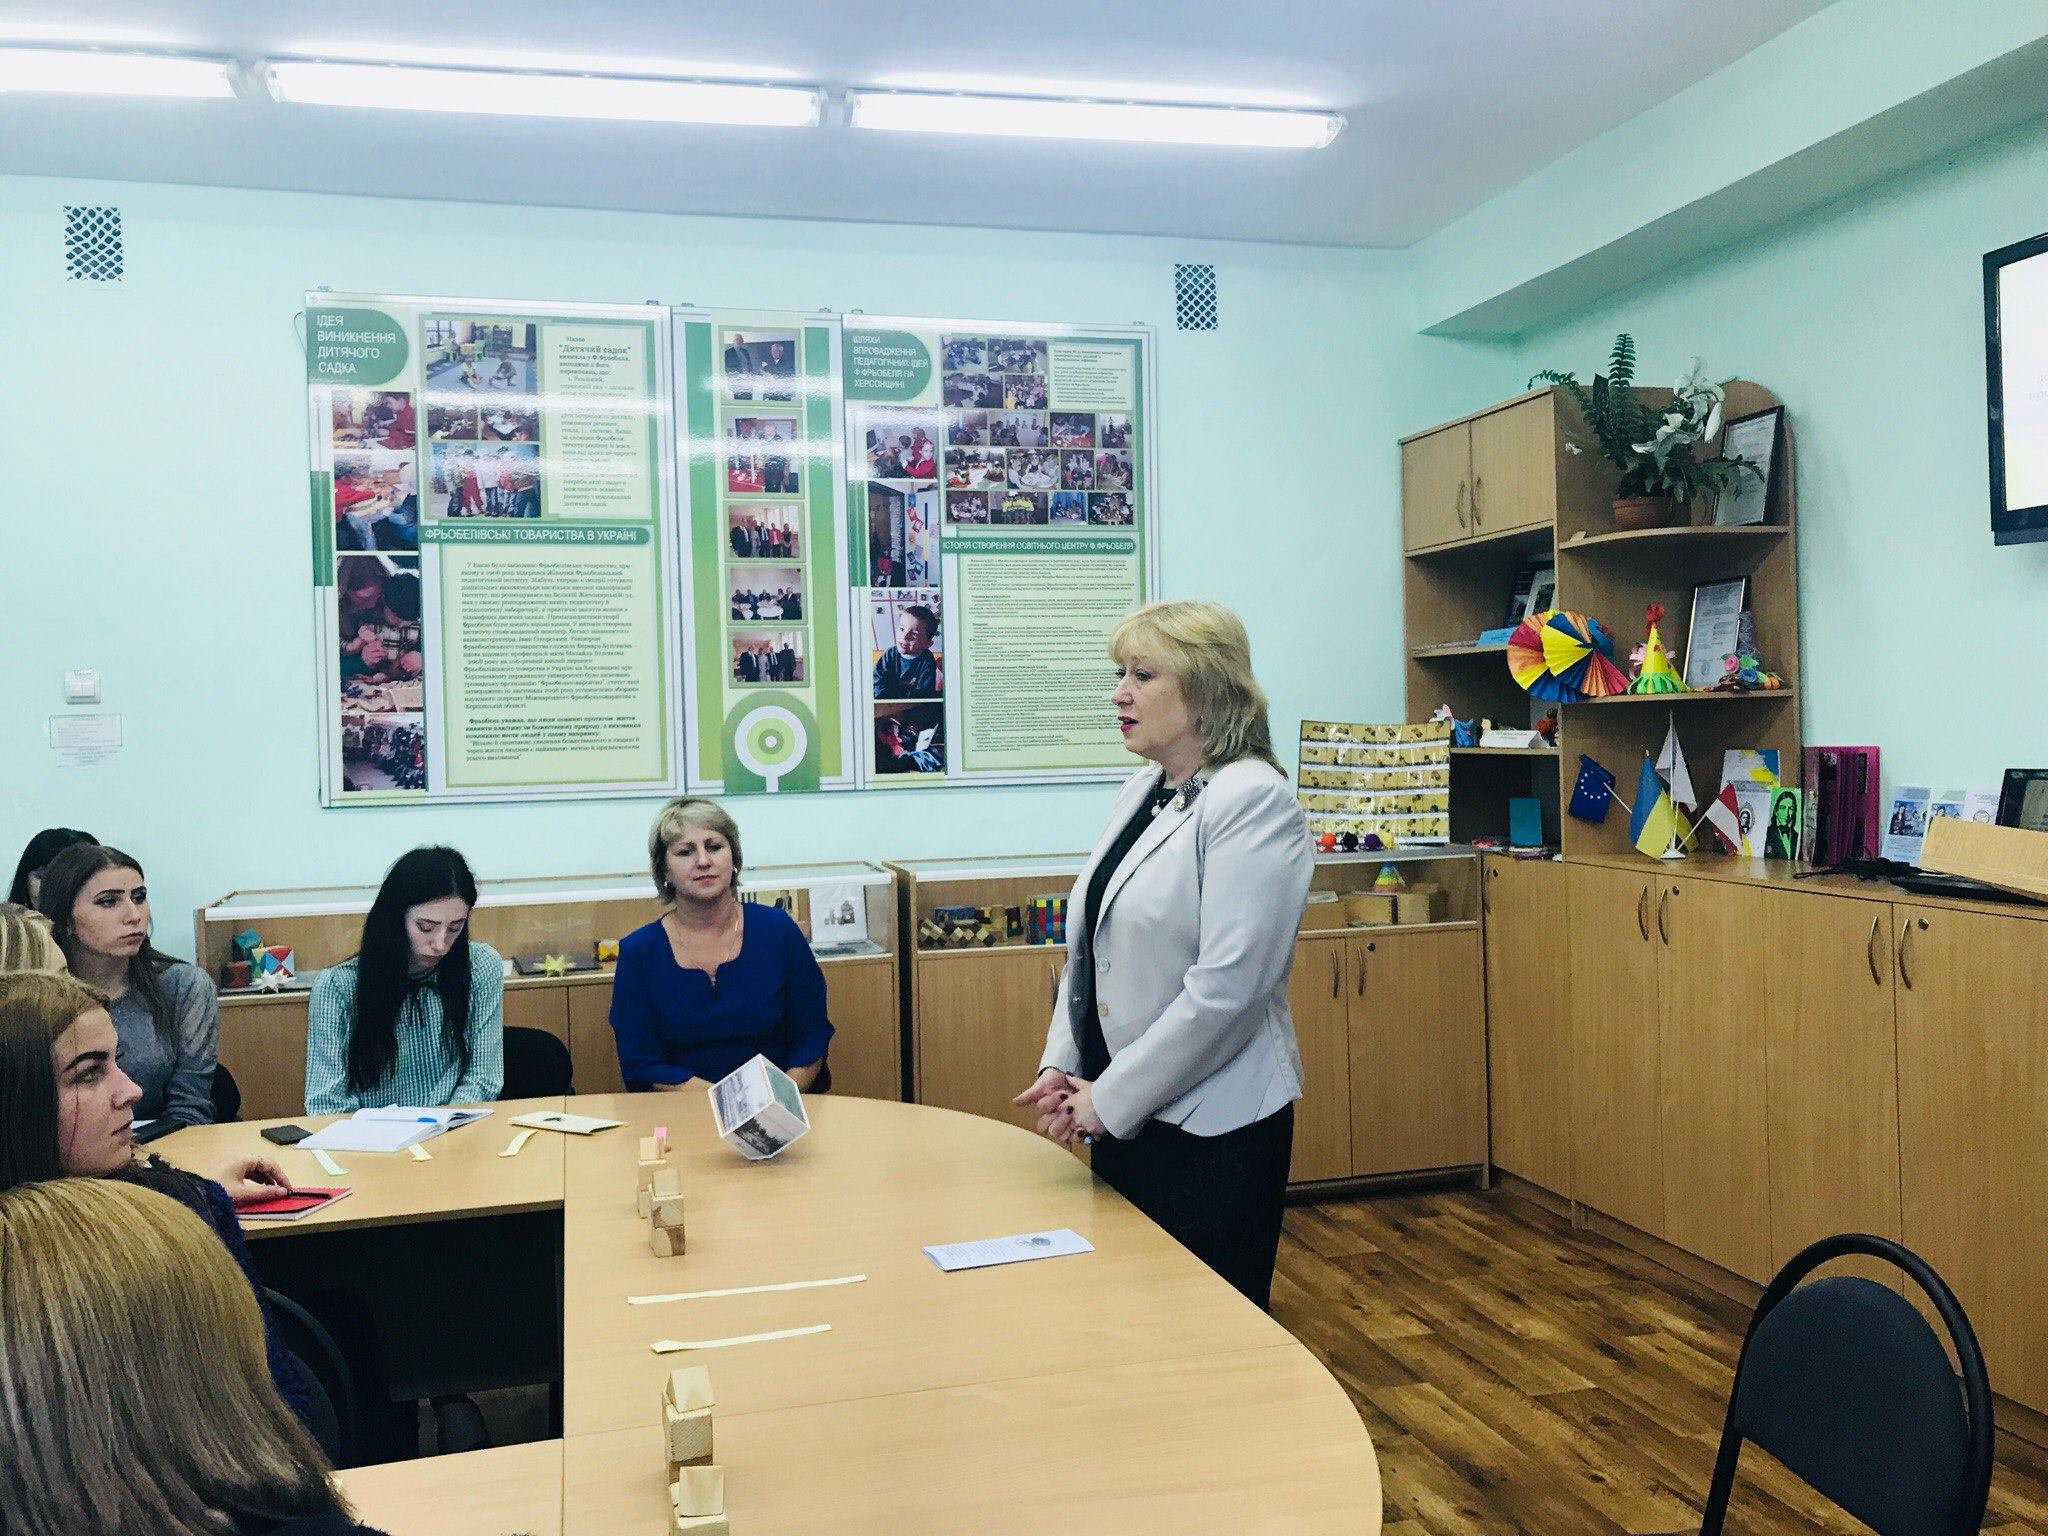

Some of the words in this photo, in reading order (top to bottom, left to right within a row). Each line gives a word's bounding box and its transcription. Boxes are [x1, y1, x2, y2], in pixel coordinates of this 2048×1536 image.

[316, 315, 344, 327] ІДЕЯ
[317, 330, 396, 343] ВИНИКНЕННЯ
[318, 346, 380, 359] ДИТЯЧОГО
[853, 346, 917, 356] ВПРОВАДЖЕННЯ
[318, 362, 357, 374] САДКА
[853, 357, 911, 367] ПЕДАГОГІЧНИХ
[912, 359, 929, 369] ІДЕЙ
[862, 368, 903, 378] ФРЬОБЕЛЯ
[904, 370, 915, 378] НА
[425, 528, 511, 540] ФРЬОБЕЛІВСЬКІ
[513, 529, 586, 541] ТОВАРИСТВА
[587, 529, 595, 541] В
[597, 528, 637, 541] УКРАЇНІ
[943, 541, 970, 550] ІСТОРІЯ
[972, 541, 1015, 550] СТВОРЕННЯ
[1016, 541, 1060, 550] ОСВІТНЬОГО
[1062, 541, 1089, 551] ЦЕНТРУ
[1097, 541, 1134, 551] ФРЬОБЕЛЯ
